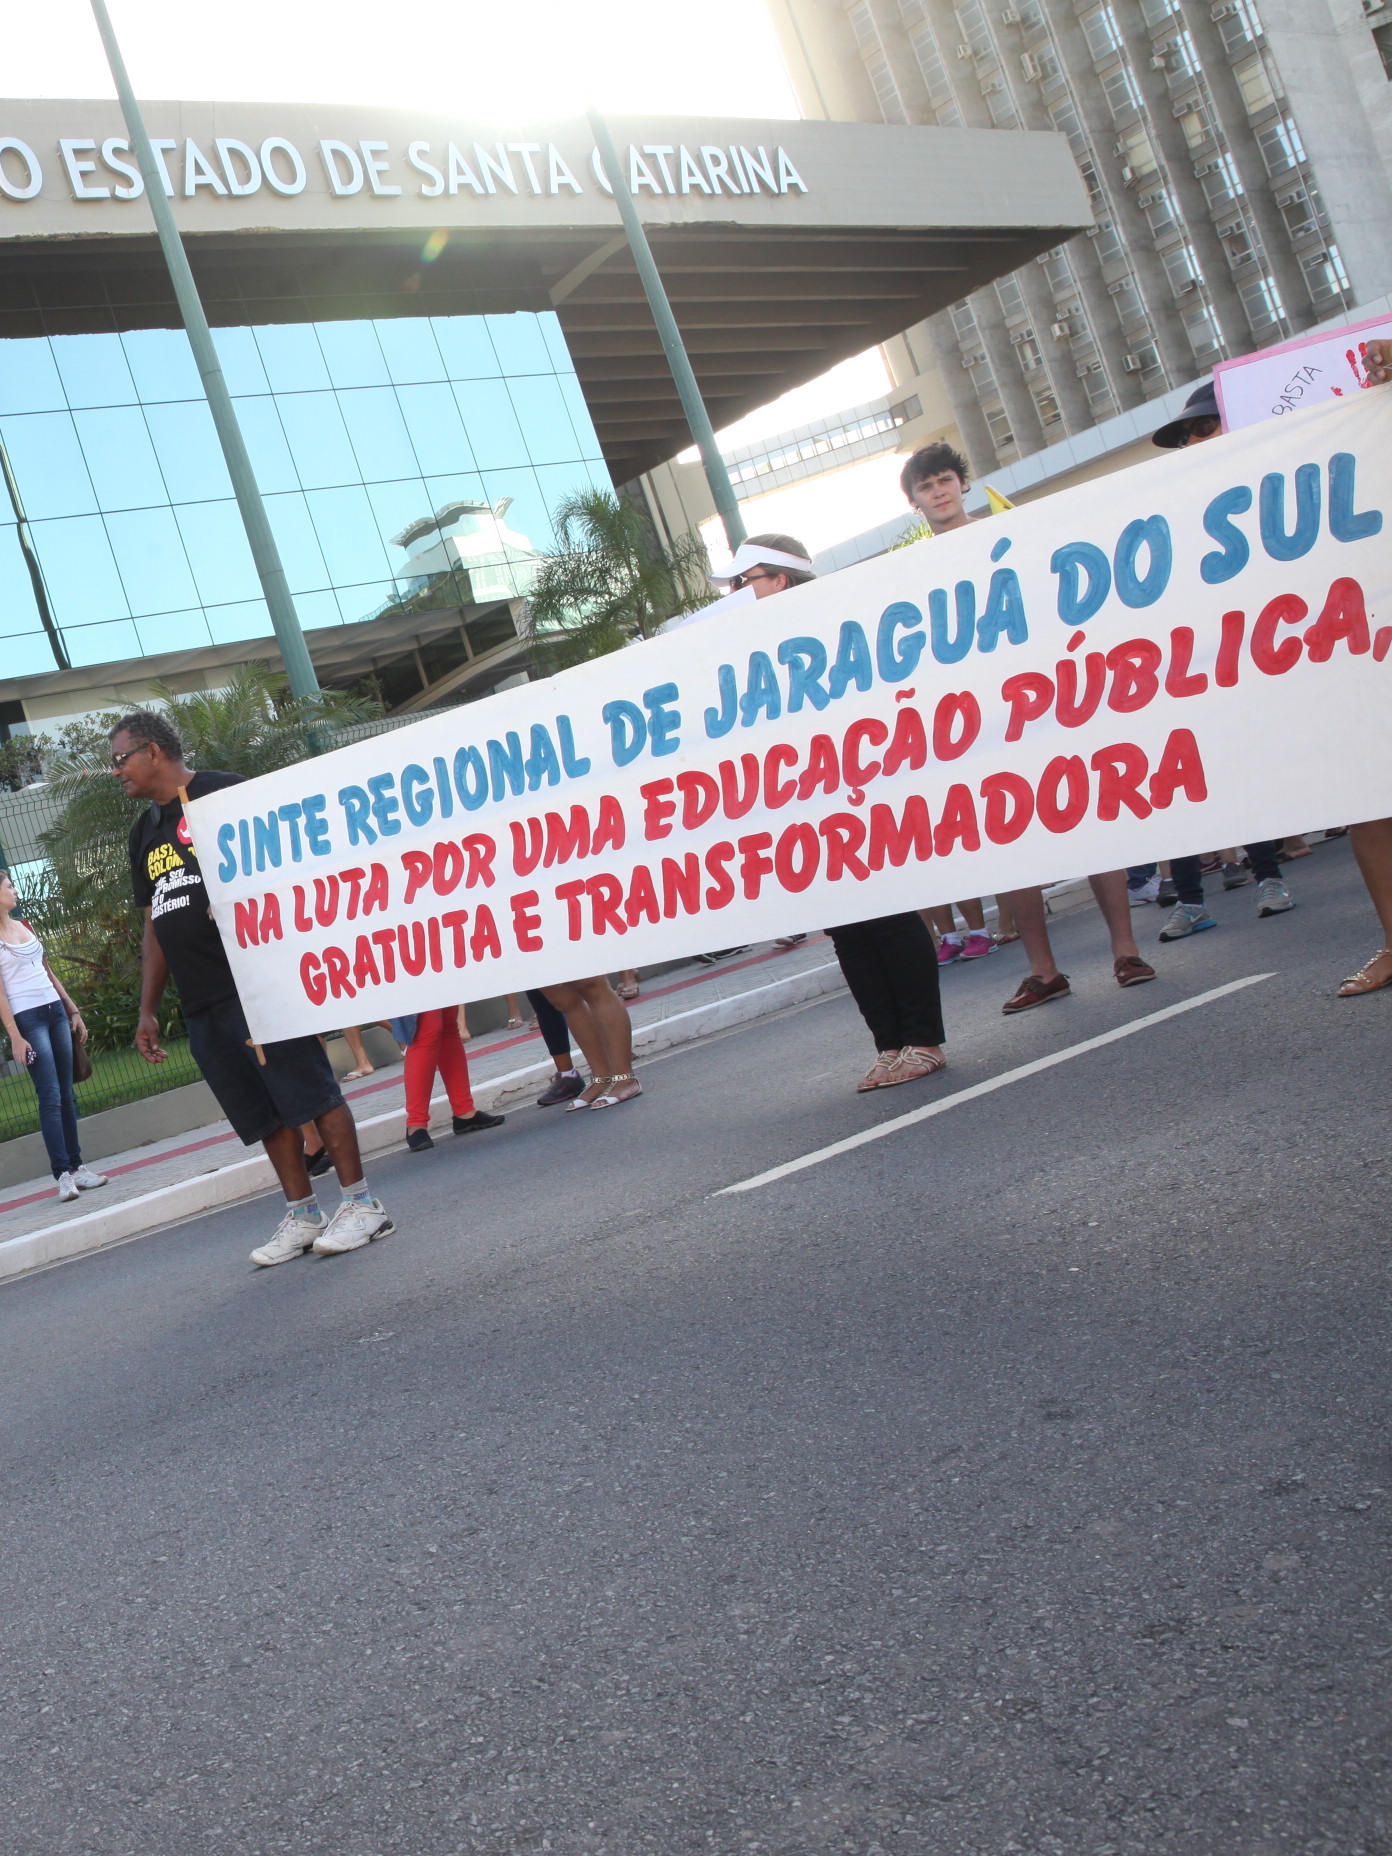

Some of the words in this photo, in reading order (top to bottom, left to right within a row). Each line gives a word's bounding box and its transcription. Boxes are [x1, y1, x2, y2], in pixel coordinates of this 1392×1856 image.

[57, 136, 308, 200] ESTADO
[320, 139, 402, 197] DE
[408, 140, 584, 197] SANTA
[1271, 366, 1324, 416] BASTA
[217, 793, 332, 883] SINTE
[338, 714, 591, 846] REGIONAL
[603, 682, 683, 768] DE
[705, 537, 1029, 739] JARAGUÁ
[1051, 513, 1174, 626] DO
[1200, 452, 1384, 585] SUL
[233, 892, 284, 949] NA
[292, 862, 389, 932] LUTA
[401, 832, 497, 904] POR
[509, 804, 625, 877] UMA
[640, 687, 982, 841] EDUCAÇÃO
[148, 843, 176, 867] BAST
[169, 868, 185, 880] SEU
[300, 904, 502, 1006] GRATUITA
[510, 890, 544, 953] E
[555, 728, 1209, 942] TRANSFORMADORA
